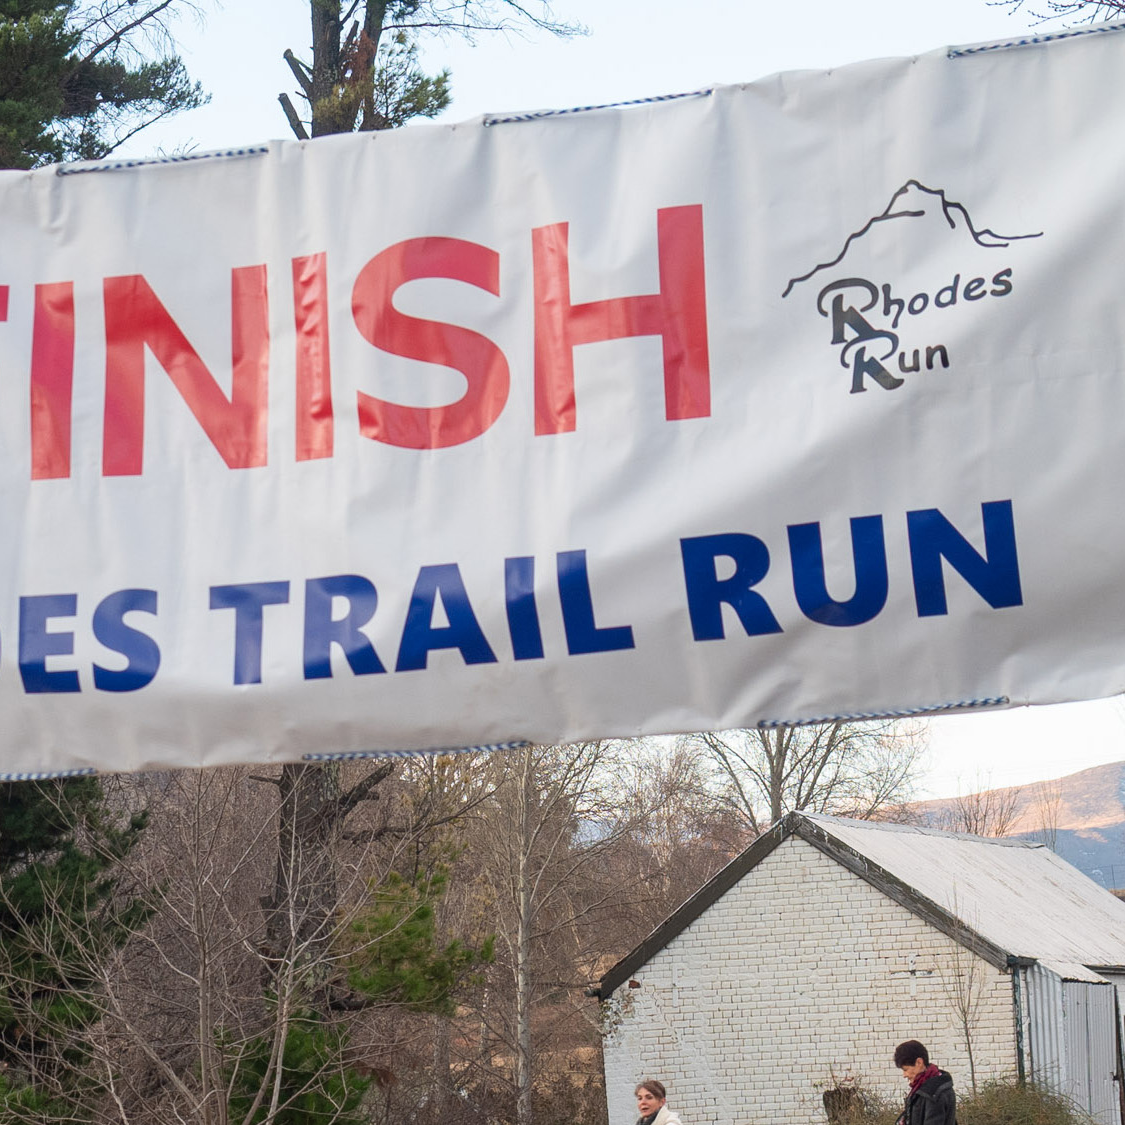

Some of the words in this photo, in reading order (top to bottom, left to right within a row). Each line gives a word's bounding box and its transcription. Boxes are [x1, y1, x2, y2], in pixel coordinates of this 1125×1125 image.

[816, 267, 1013, 345] Rhodes
[840, 329, 951, 394] Run
[209, 550, 636, 687] TRAIL
[679, 499, 1025, 642] RUN
